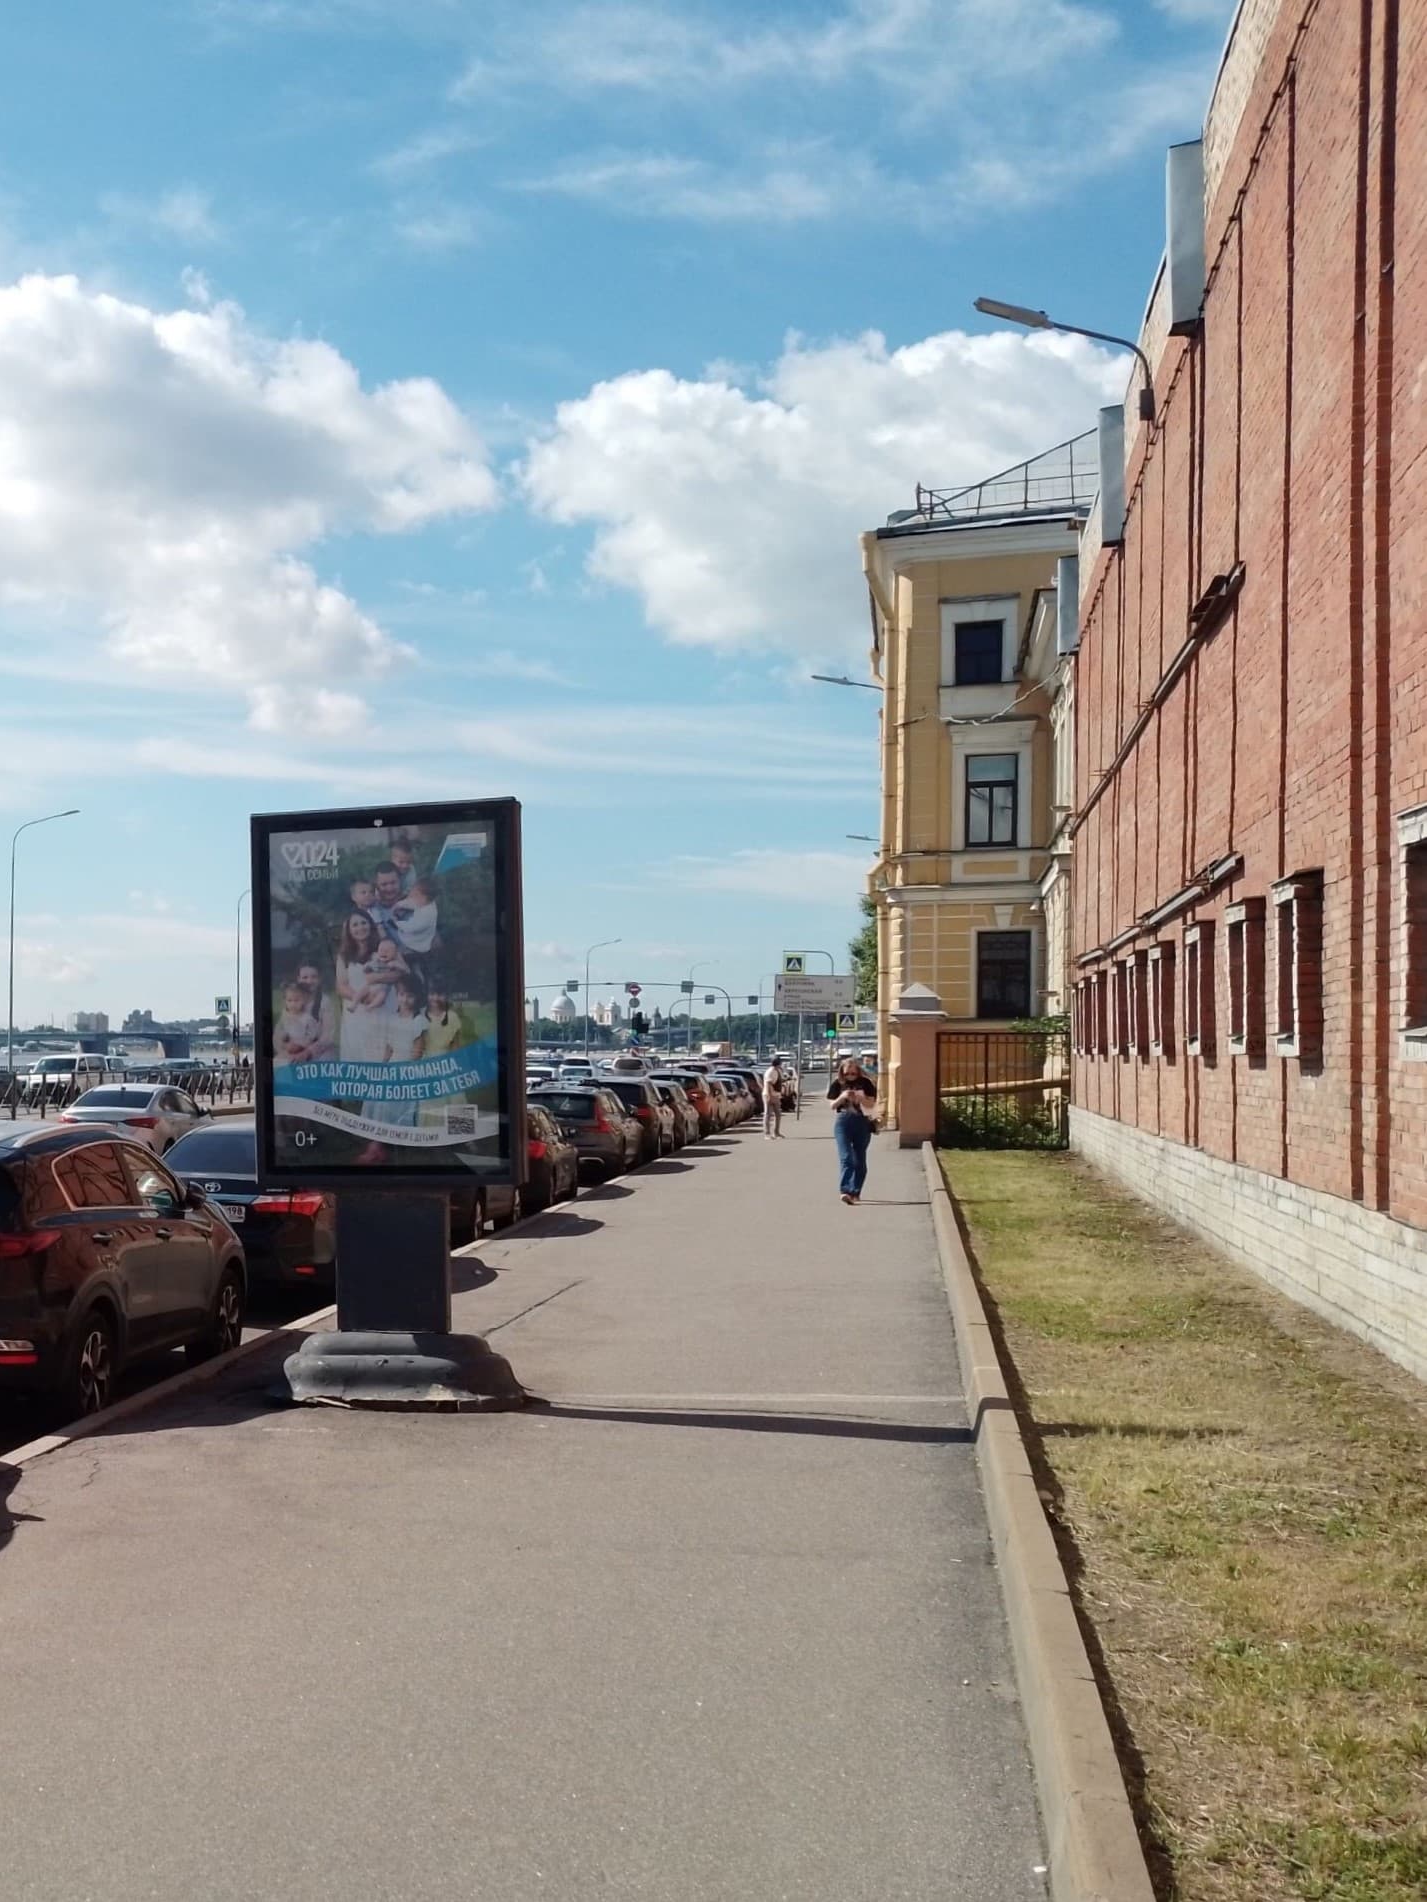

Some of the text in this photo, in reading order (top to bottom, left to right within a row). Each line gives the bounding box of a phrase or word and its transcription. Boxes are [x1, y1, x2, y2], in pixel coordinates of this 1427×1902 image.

[291, 840, 340, 868] 2024
[296, 1063, 318, 1080] ЭТО
[320, 1063, 344, 1079] КАК
[345, 1064, 397, 1081] ЛУЧШАЯ
[331, 1069, 481, 1100] КОТОРАЯ БОЛЕЕТ ЗА ТЕБЯ
[295, 1131, 318, 1147] 0+
